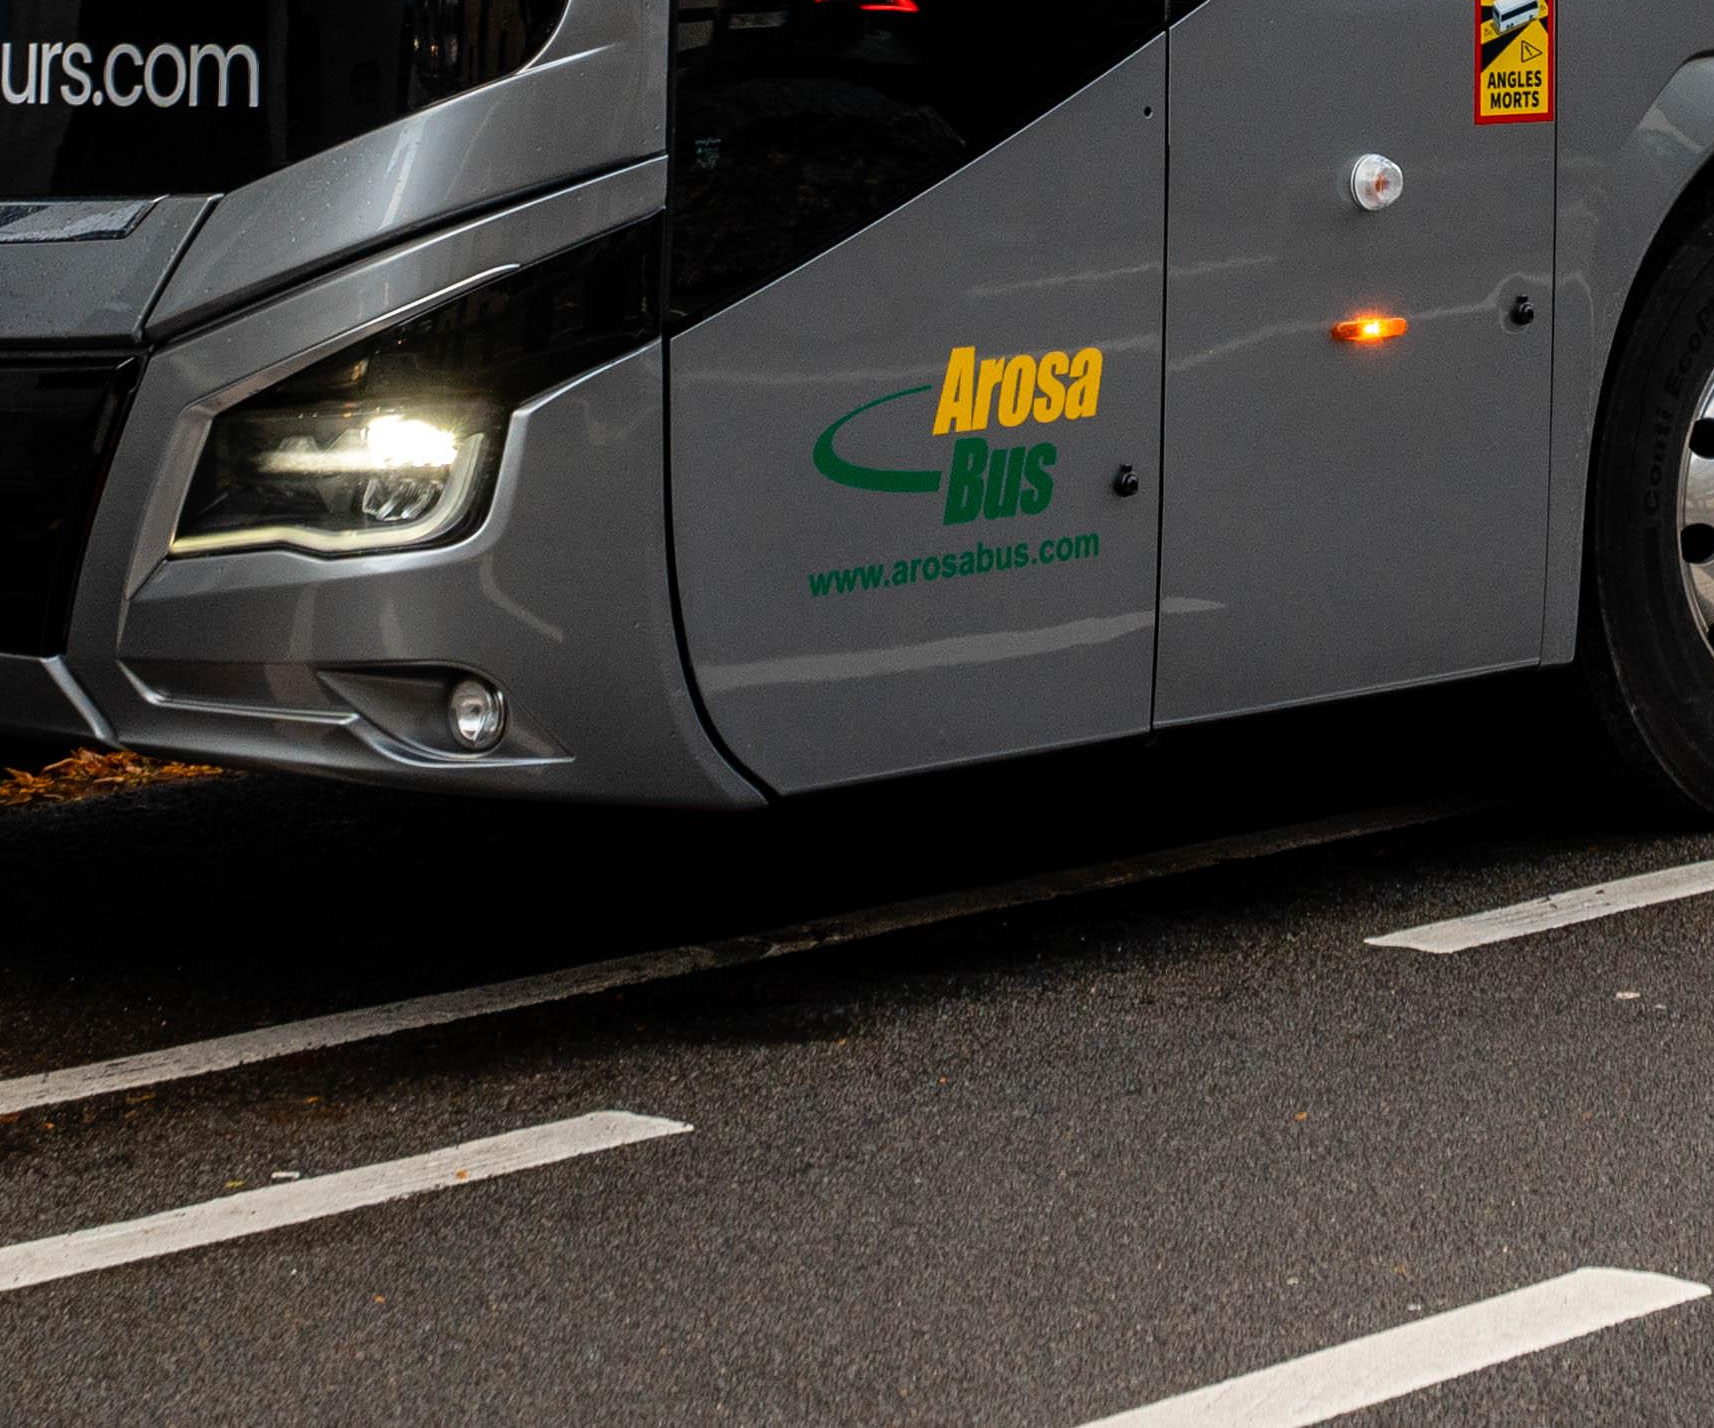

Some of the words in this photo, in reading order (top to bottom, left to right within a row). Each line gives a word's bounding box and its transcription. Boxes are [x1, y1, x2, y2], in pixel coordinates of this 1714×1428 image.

[1488, 71, 1542, 89] ANGLES
[1491, 92, 1539, 109] MORTS
[932, 345, 1102, 436] Arosa
[942, 436, 1056, 525] Bus
[808, 531, 1100, 598] www.arosabus.com
